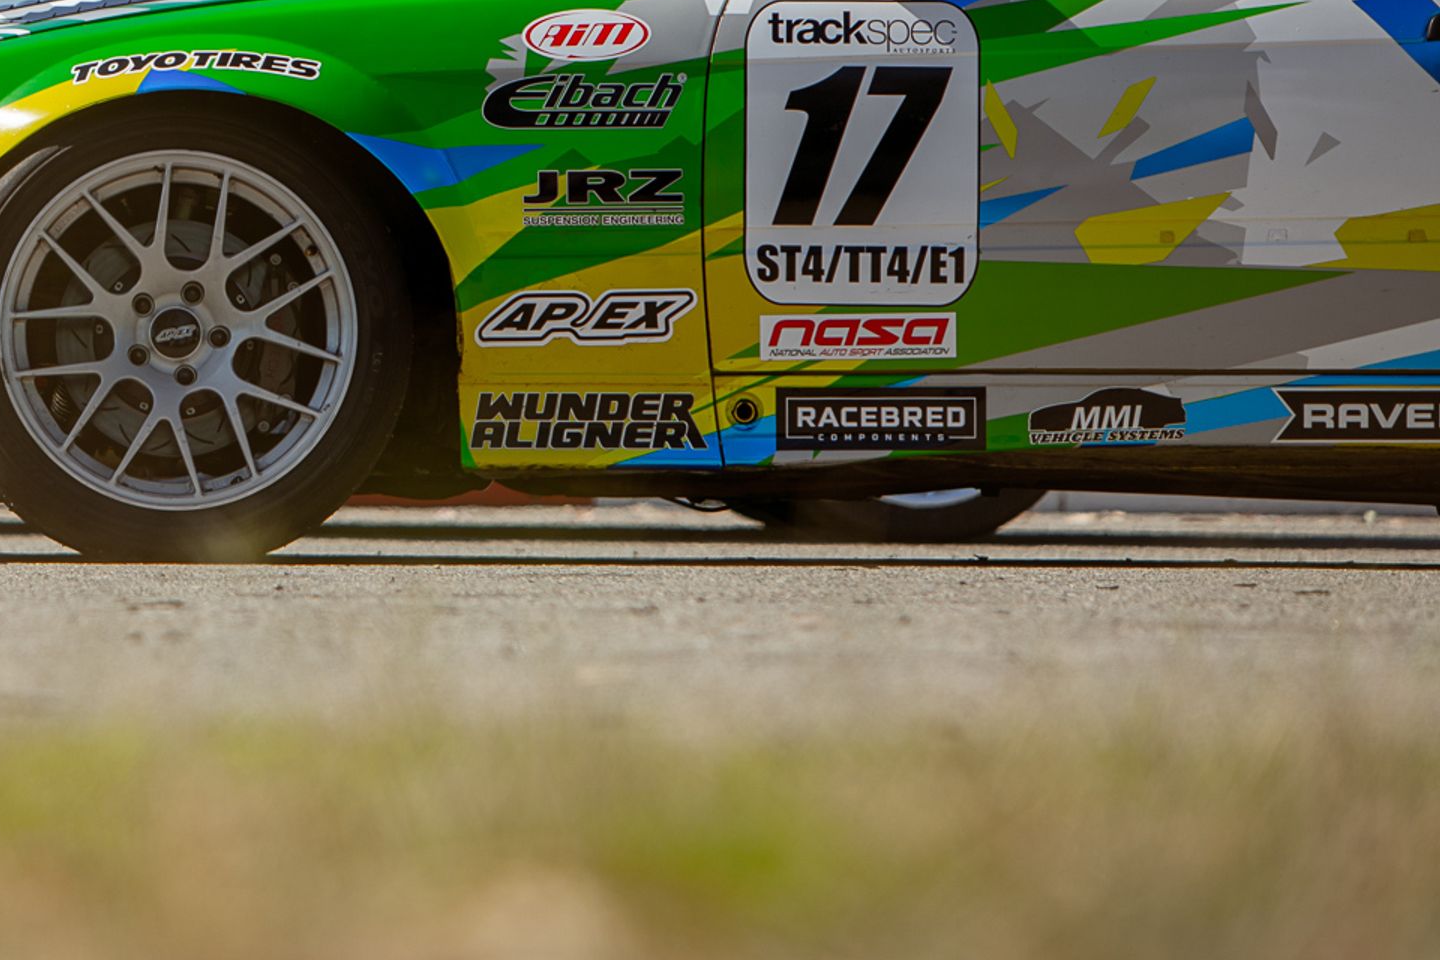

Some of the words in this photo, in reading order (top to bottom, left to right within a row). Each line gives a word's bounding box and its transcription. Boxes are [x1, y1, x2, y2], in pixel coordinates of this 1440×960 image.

[768, 11, 957, 53] trackspec
[73, 52, 188, 83] TOYO
[192, 52, 320, 79] TIRES
[482, 73, 685, 129] Eibach
[771, 65, 954, 226] 17
[523, 169, 685, 204] JRZ
[523, 214, 600, 225] SUSPENSION
[602, 213, 684, 225] ENGINEERING
[757, 244, 965, 284] ST4/TT4/E1
[769, 348, 817, 357] NATIONAL
[818, 348, 847, 357] AUTO
[848, 347, 883, 357] SPORT
[883, 347, 950, 356] ASSOCIATION
[475, 392, 695, 422] WUNDER
[796, 406, 967, 428] RACEBRED
[1070, 404, 1143, 431] MMI
[1303, 403, 1440, 429] RAVE
[470, 421, 690, 449] ALIGNER
[817, 433, 946, 441] COMPONENTS
[1030, 430, 1105, 444] VEHICLE
[1108, 428, 1185, 442] SYSTEMS
